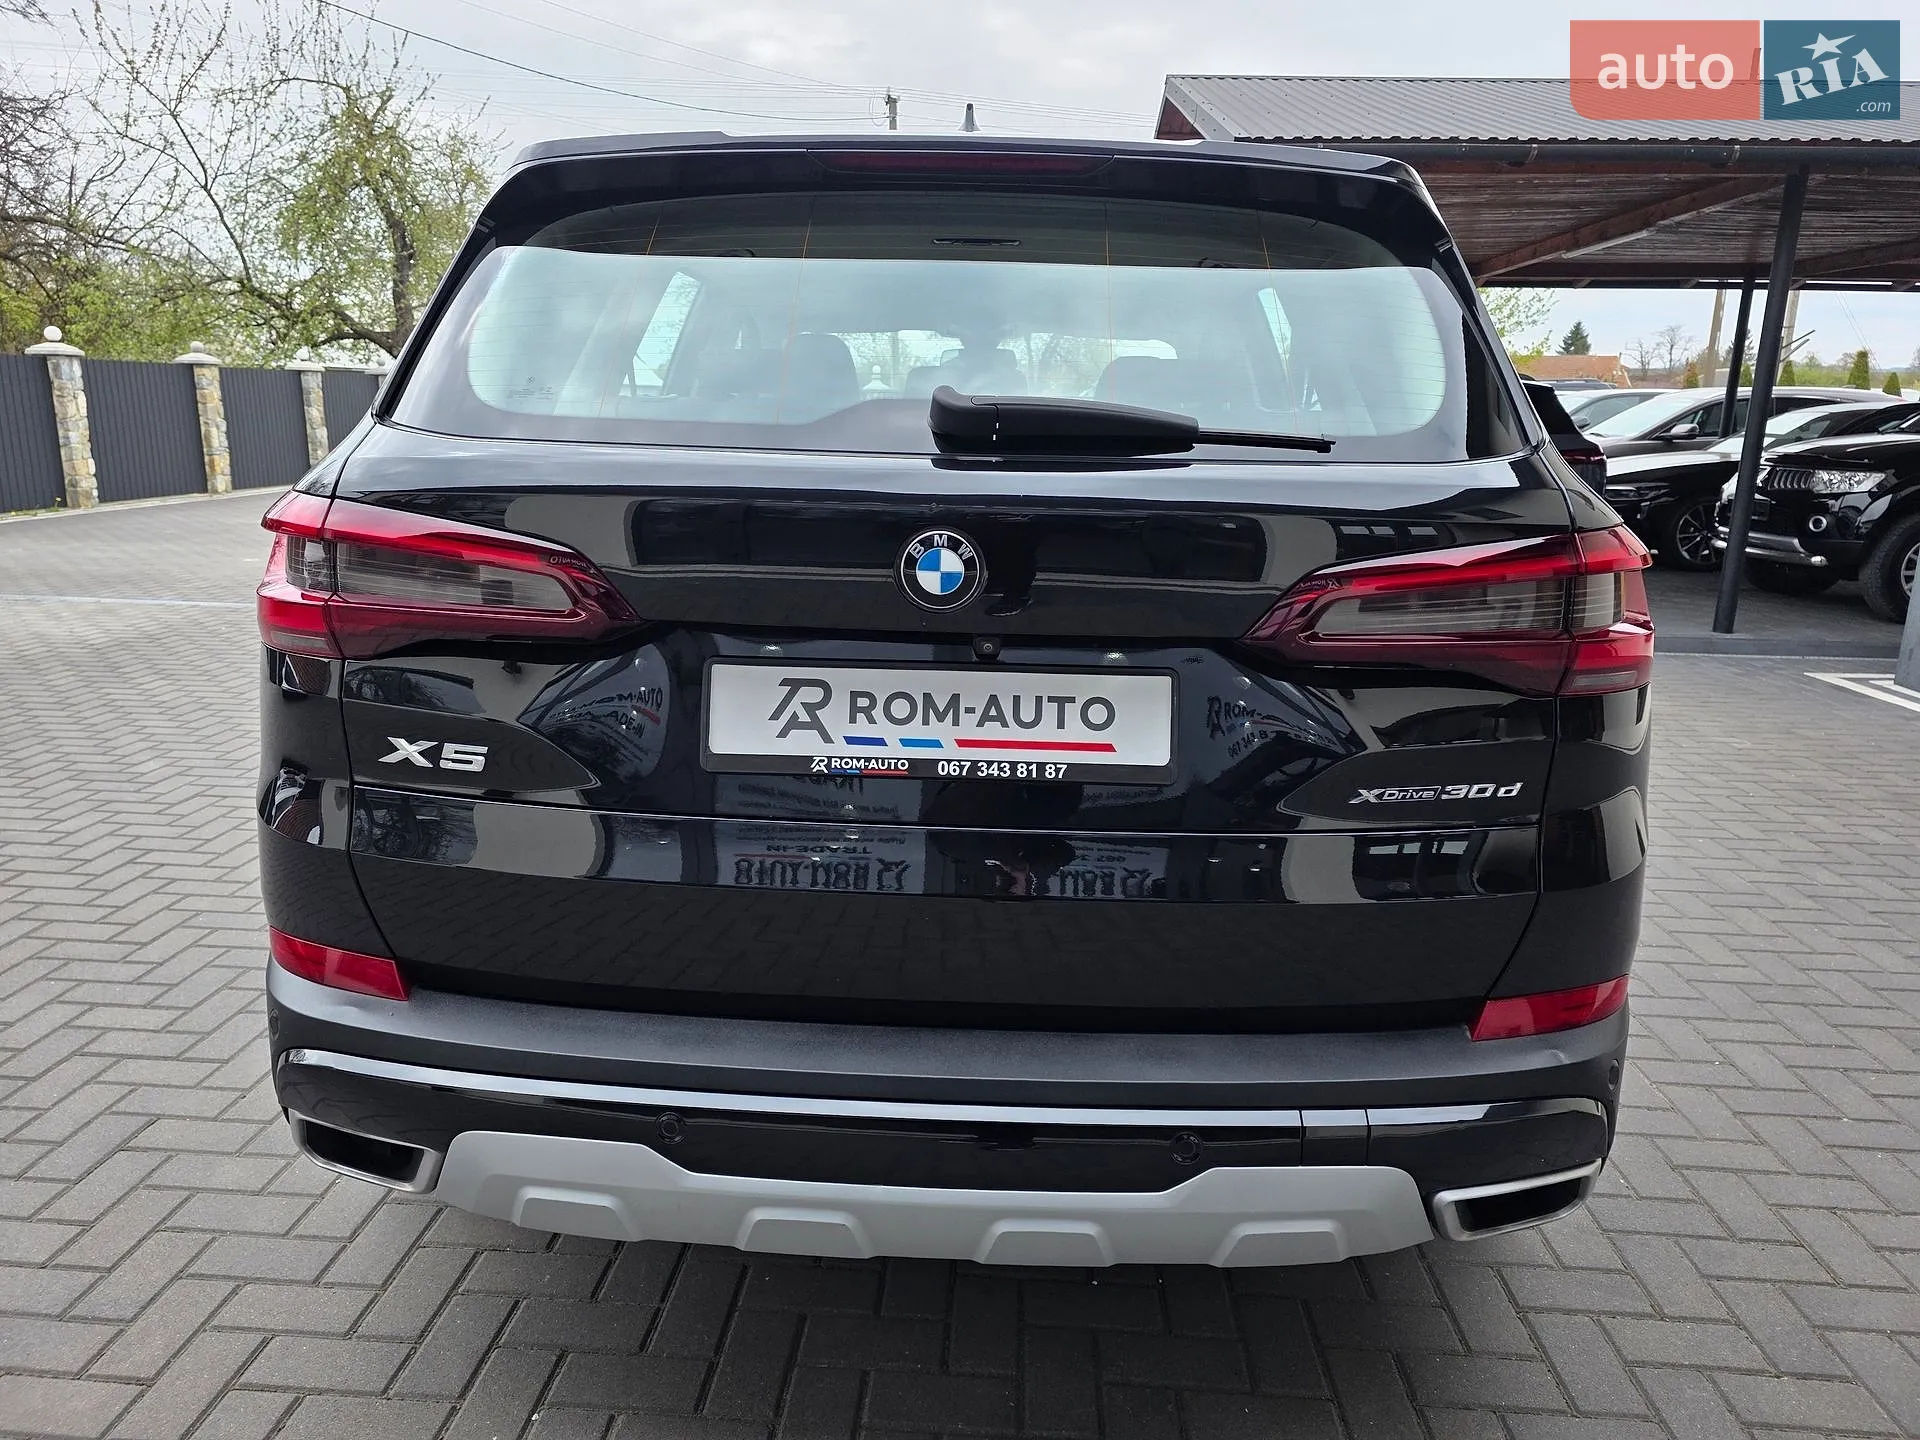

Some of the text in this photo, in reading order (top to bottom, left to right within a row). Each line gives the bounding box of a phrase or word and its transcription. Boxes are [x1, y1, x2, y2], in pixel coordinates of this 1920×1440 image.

[909, 534, 973, 560] BMW
[848, 690, 1117, 732] ROM-AUTO
[378, 736, 489, 772] X5
[831, 757, 909, 772] ROM-AUTO
[938, 761, 1068, 780] 067 343 81 87
